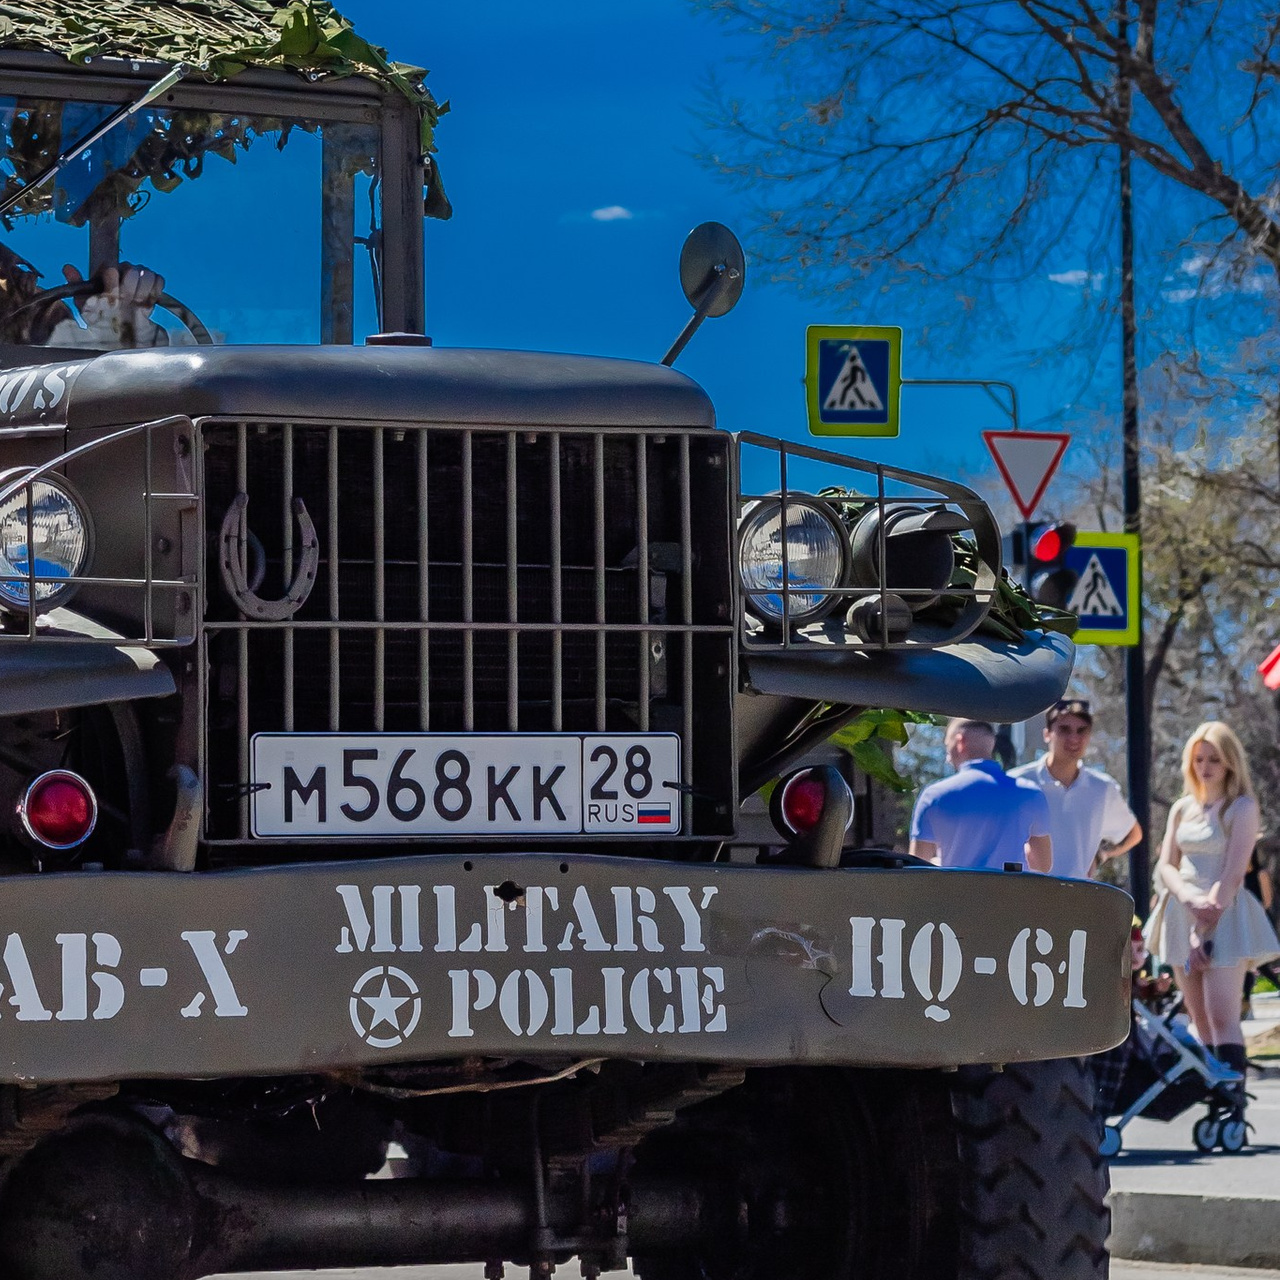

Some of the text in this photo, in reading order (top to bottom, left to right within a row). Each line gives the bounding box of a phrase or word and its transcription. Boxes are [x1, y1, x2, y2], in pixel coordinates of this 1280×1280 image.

[590, 745, 652, 800] 28
[589, 804, 634, 823] RUS
[335, 885, 718, 952] MILITARY
[448, 967, 727, 1037] POLICE
[849, 916, 1087, 1022] HQ-61
